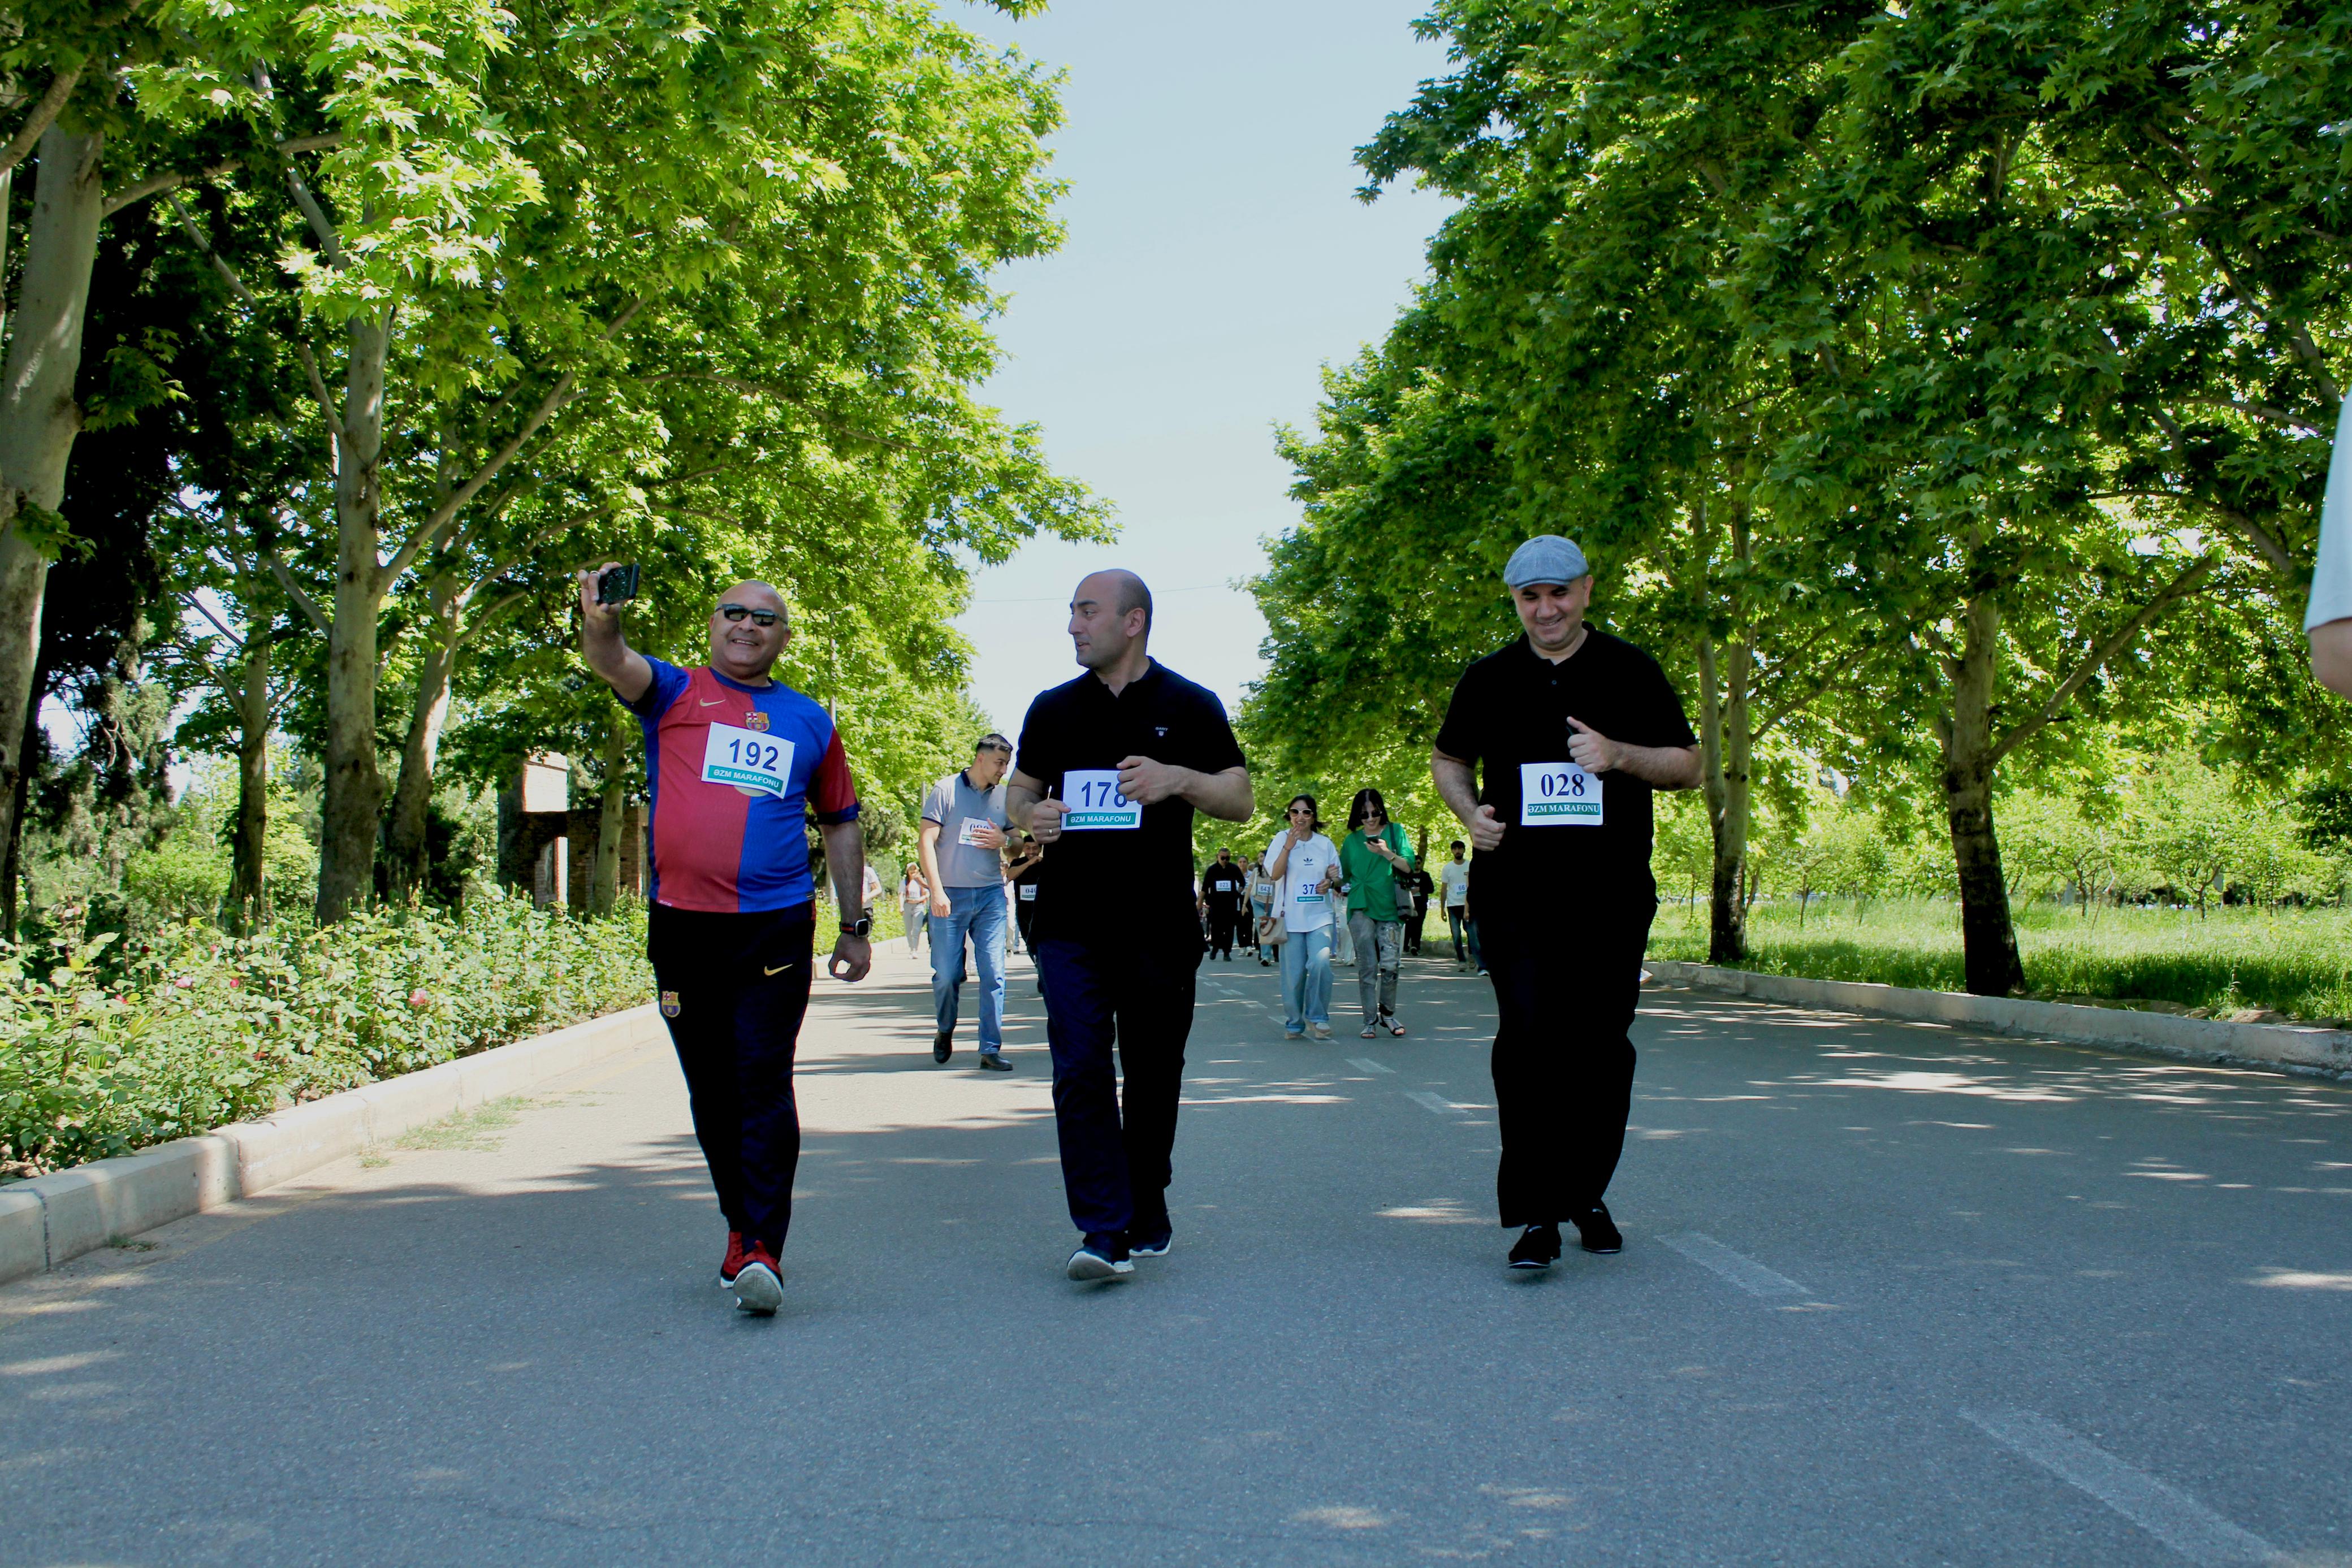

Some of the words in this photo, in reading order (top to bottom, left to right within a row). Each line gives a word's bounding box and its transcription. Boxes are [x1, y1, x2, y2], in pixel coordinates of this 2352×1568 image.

[729, 738, 779, 772] 192
[713, 769, 732, 778] ƏZM
[733, 772, 780, 788] MARAFONU
[1541, 773, 1585, 797] 028
[1528, 805, 1547, 813] ƏZM
[1549, 804, 1600, 813] MARAFONU
[1302, 884, 1320, 895] 37
